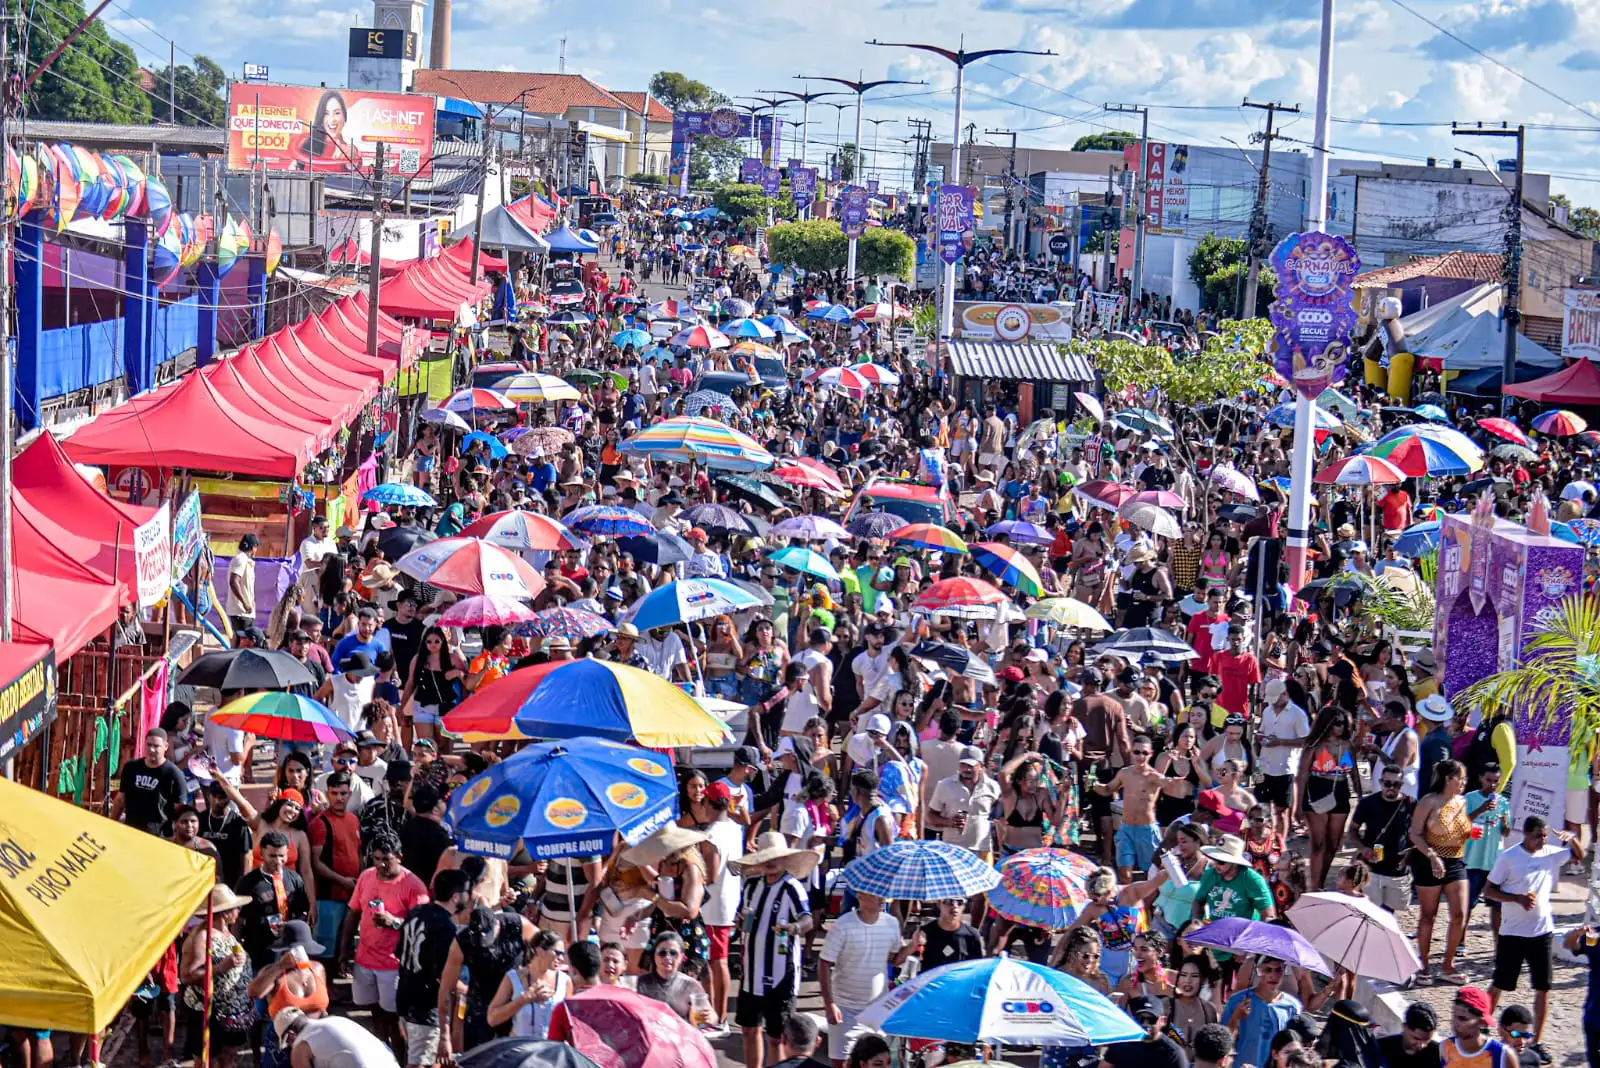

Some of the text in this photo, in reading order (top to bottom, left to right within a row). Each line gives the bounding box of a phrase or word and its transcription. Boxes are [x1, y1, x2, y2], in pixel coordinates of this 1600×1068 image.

[368, 31, 385, 44] FC
[250, 107, 294, 117] INTERNET
[234, 118, 301, 130] QUE CONECTA
[247, 133, 285, 147] CODÓ!
[1051, 241, 1068, 249] LOOP
[1286, 258, 1355, 275] CARNAVAL
[1300, 327, 1329, 336] SECULT
[135, 774, 160, 789] POLO
[464, 838, 494, 852] COMPRE
[536, 838, 604, 856] COMPRE AQUI
[26, 831, 107, 908] PURO MALTE
